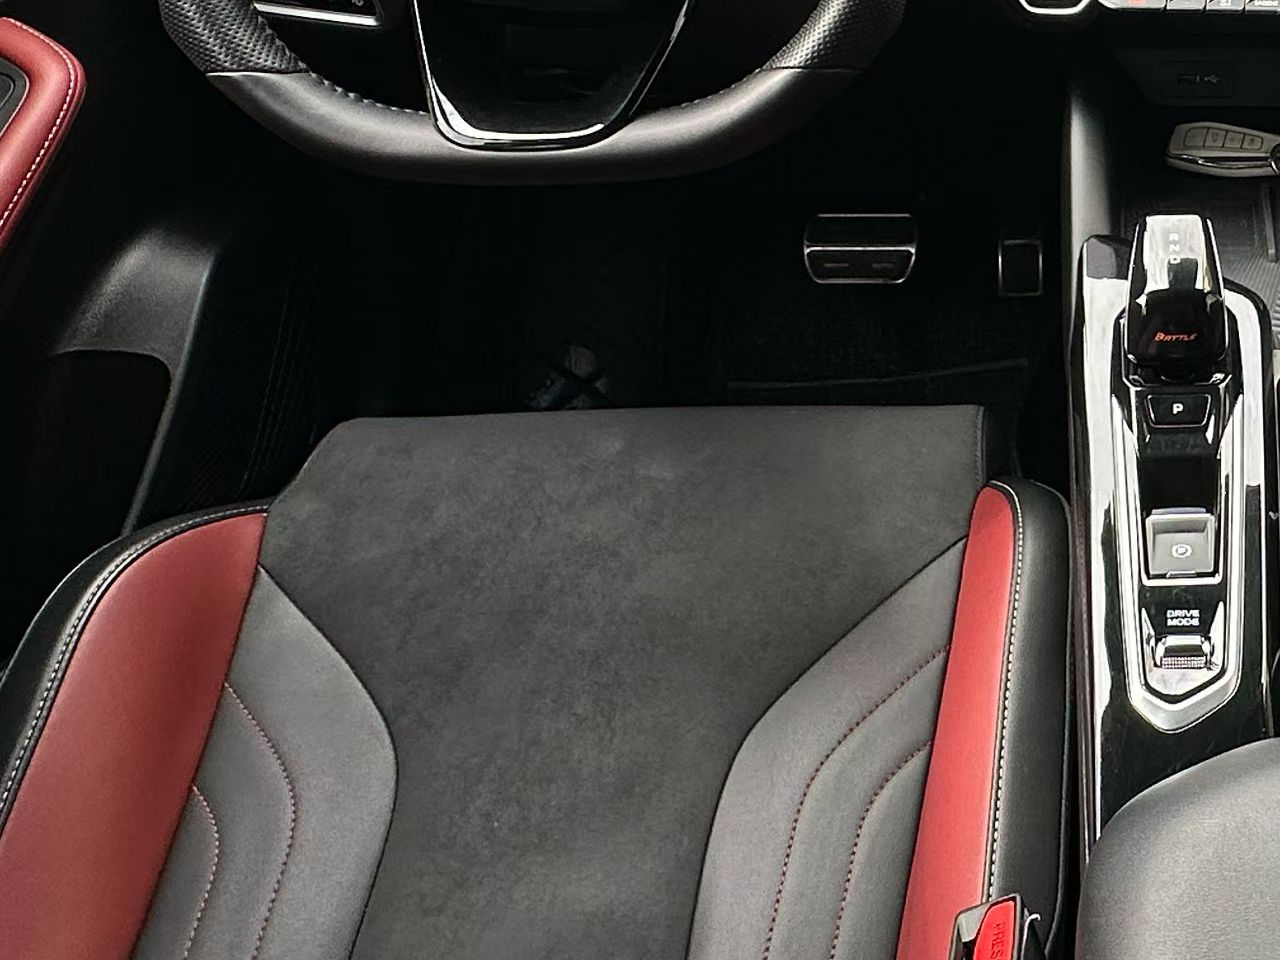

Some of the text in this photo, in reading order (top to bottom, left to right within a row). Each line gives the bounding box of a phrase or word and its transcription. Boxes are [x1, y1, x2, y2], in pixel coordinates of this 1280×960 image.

[1173, 404, 1184, 414] P
[1166, 609, 1200, 618] DRIVE
[1167, 617, 1200, 626] MODE
[990, 921, 1006, 960] PRES
